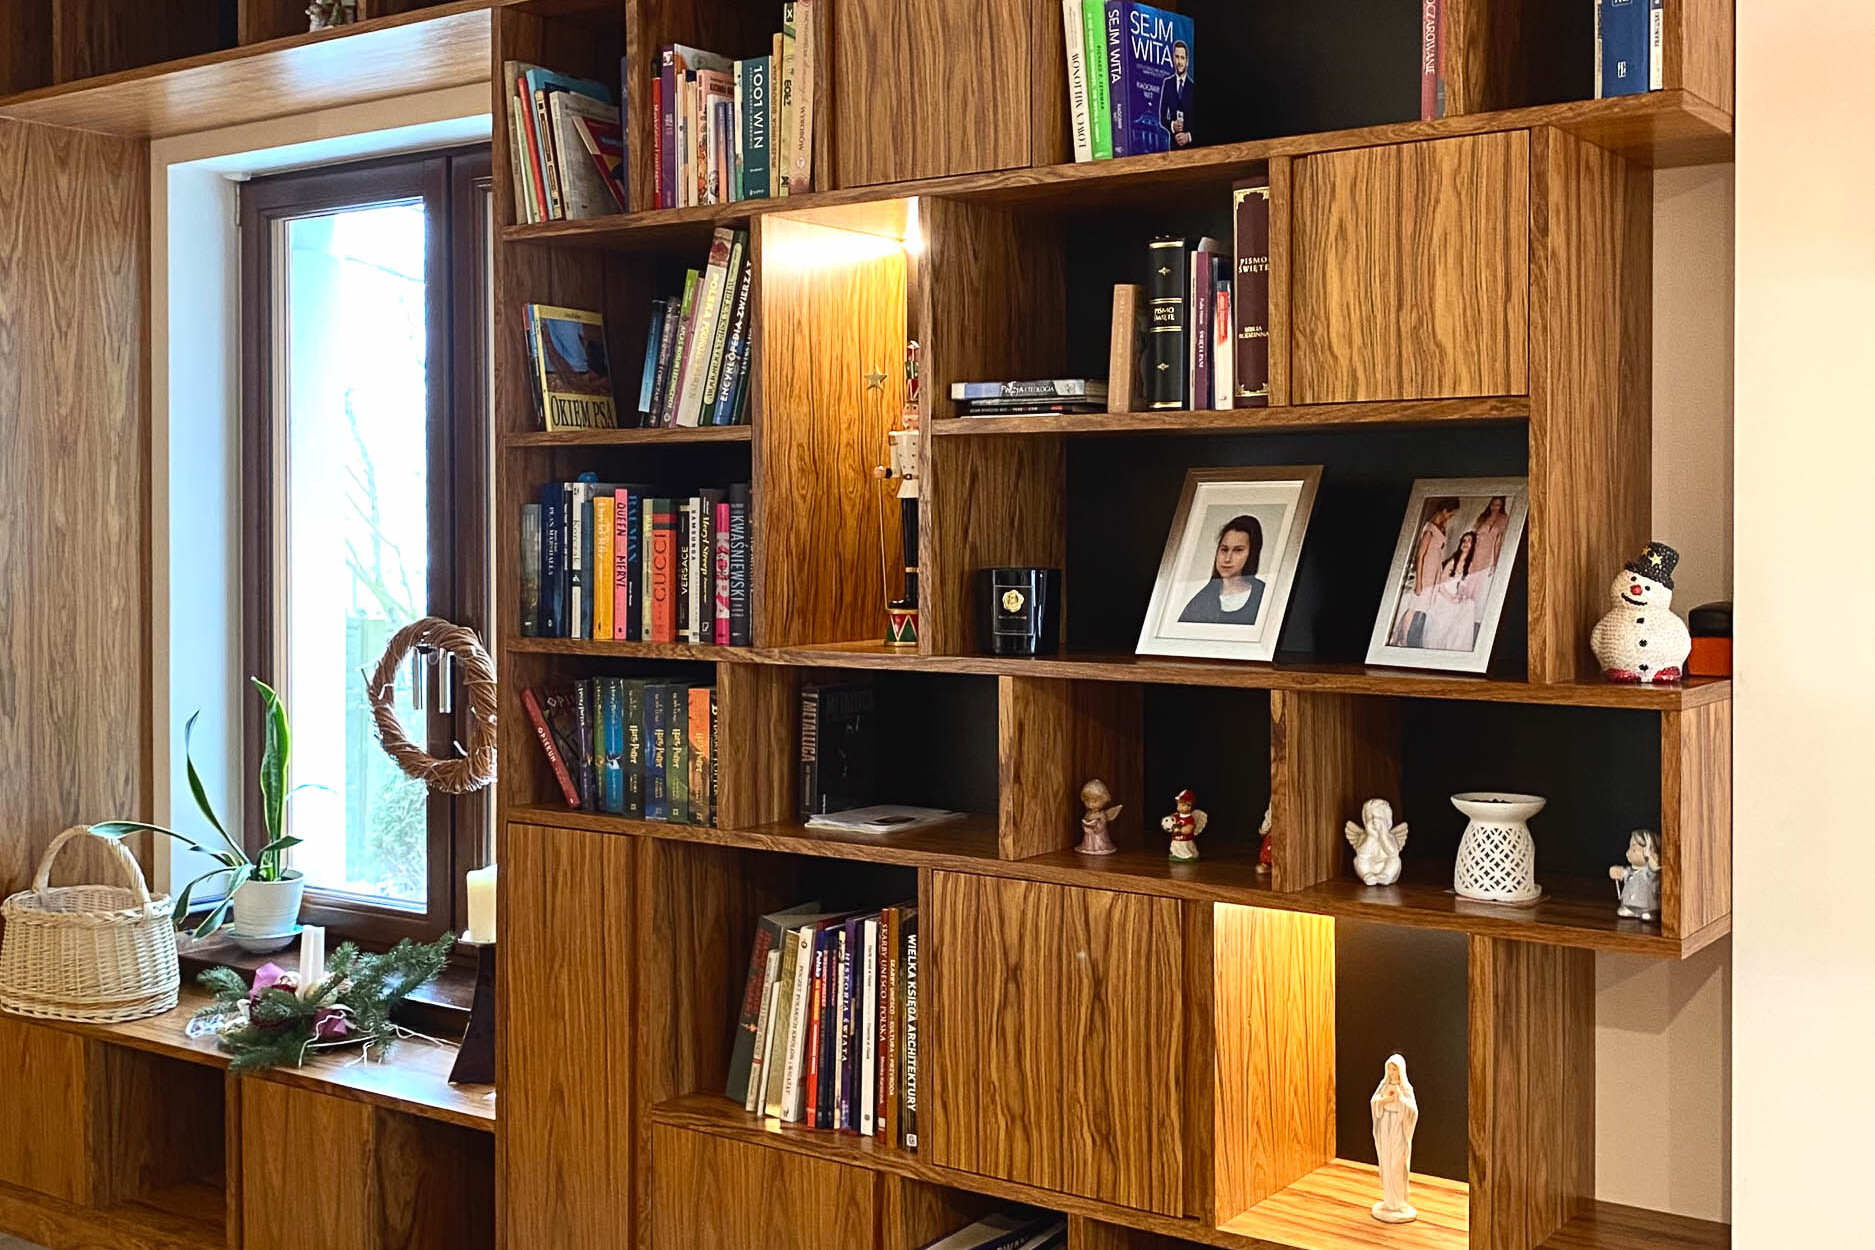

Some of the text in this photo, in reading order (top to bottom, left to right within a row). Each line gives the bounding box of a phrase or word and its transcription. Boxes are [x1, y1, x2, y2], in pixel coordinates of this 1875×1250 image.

[1108, 9, 1121, 84] SEJM WITA
[1130, 11, 1173, 43] SEJM
[1132, 36, 1173, 67] WITA
[753, 66, 764, 149] 1001 WIN
[1240, 256, 1267, 265] PISMO
[721, 317, 742, 402] ENCYKLOPEDIA
[551, 395, 616, 428] OKIEM PSA
[616, 502, 626, 590] QUEEN MERYL
[700, 515, 710, 545] Meryl
[701, 545, 709, 575] Streep
[730, 515, 748, 601] KWAŚNIEWSKI
[653, 534, 667, 602] GUCCI
[716, 532, 729, 618] KORA
[537, 727, 557, 763] OPIEKUN
[802, 701, 817, 762] METALLICA
[879, 923, 888, 1042] SKARBY UNESCO POLSKA
[842, 1018, 850, 1062] ŚWIATA
[905, 934, 916, 1112] WIELKA KSIĘGA ARCHITEKTURY
